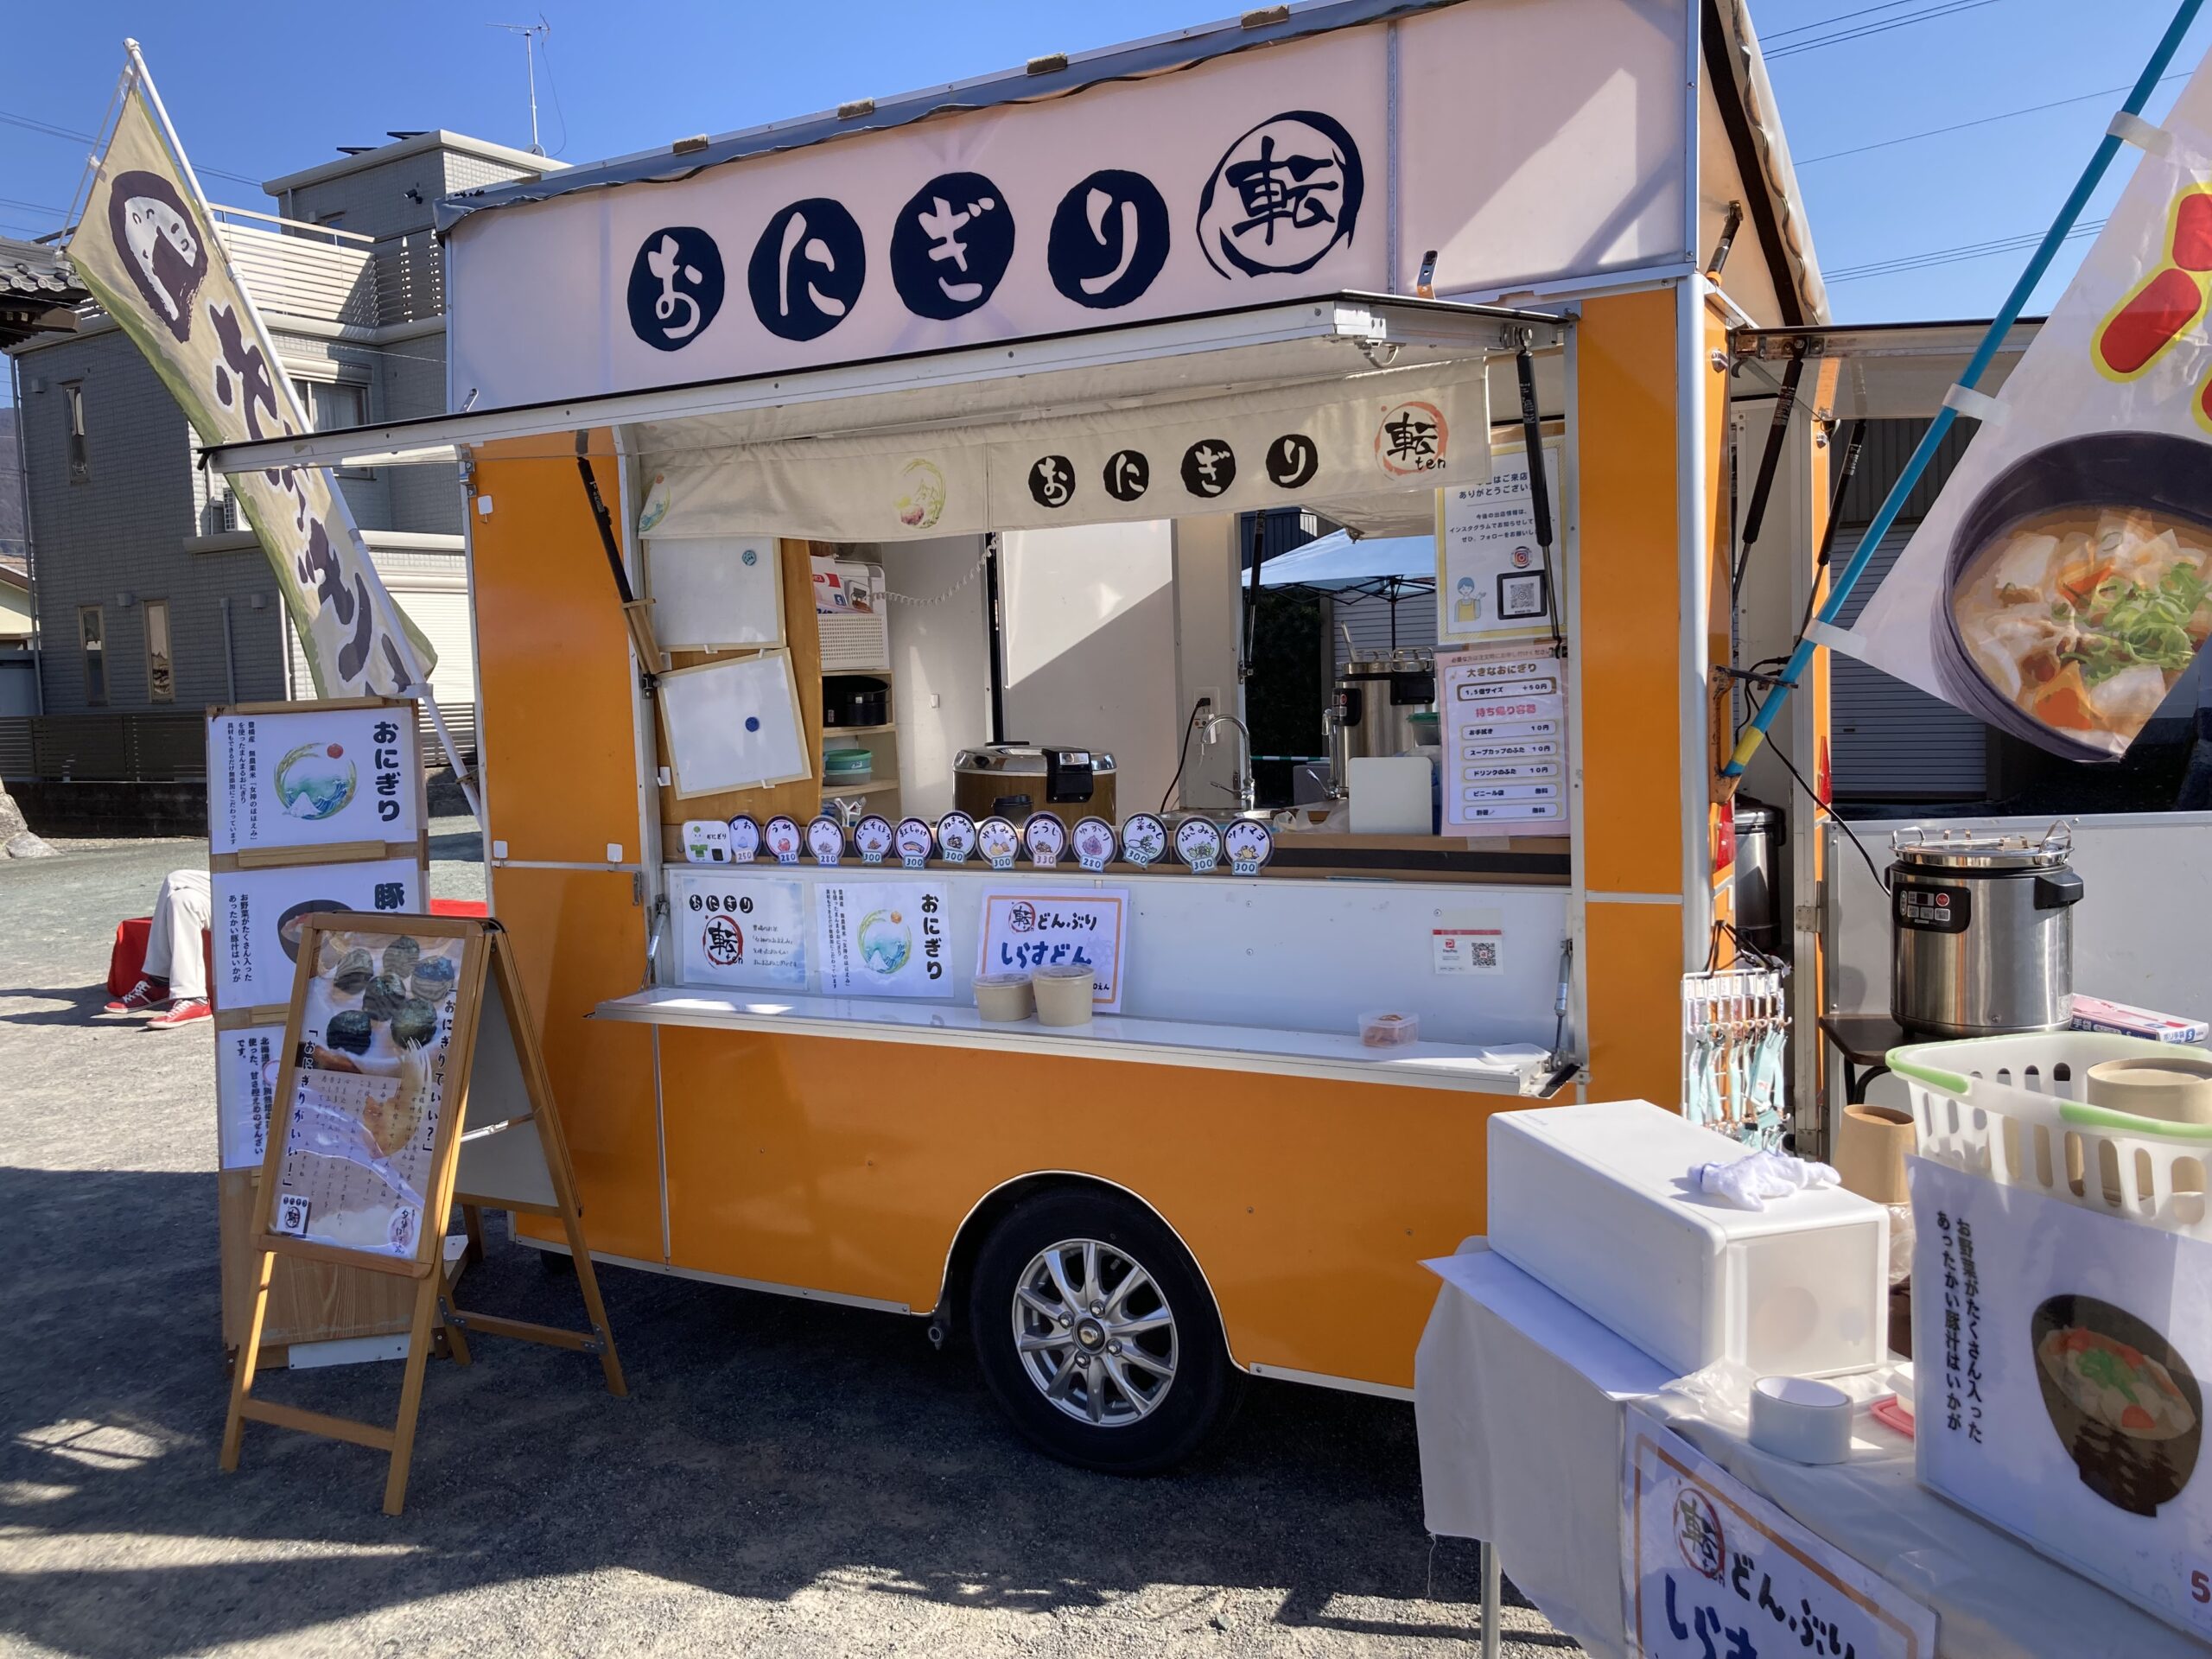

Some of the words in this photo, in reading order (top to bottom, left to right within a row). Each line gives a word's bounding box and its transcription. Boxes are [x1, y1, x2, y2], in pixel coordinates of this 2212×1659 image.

[641, 181, 1150, 343] おにぎり
[1220, 130, 1344, 251] 転
[1034, 438, 1310, 505] おにぎり
[1384, 412, 1438, 461] 転
[1416, 457, 1446, 470] ten
[1477, 471, 1529, 486] はご来店
[1459, 484, 1533, 499] ありがとうござい
[1461, 530, 1535, 543] ぜひ、フォローをお願いし
[1466, 663, 1537, 678] 大きなおにぎり
[1475, 704, 1536, 717] 持ち帰り容器
[1470, 747, 1525, 756] スープカップのふた
[238, 722, 246, 804] を使ったまんまるおにぎり
[372, 721, 401, 822] おにぎり
[1473, 767, 1516, 776] ドリンクのふた
[733, 822, 752, 830] しお
[772, 823, 791, 833] うめ
[1033, 822, 1058, 836] こうじ
[1228, 825, 1266, 842] ツナマヨ
[738, 852, 752, 861] 250
[821, 855, 836, 863] 280
[864, 853, 880, 861] 300
[907, 858, 923, 867] 300
[945, 851, 963, 861] 300
[994, 858, 1011, 867] 300
[1037, 855, 1054, 864] 330
[1083, 858, 1101, 868] 280
[1127, 850, 1147, 864] 300
[1194, 859, 1213, 869] 300
[1235, 863, 1255, 873] 300
[374, 882, 406, 912] 豚
[691, 894, 752, 913] おにぎり
[1013, 906, 1033, 927] 転
[1038, 912, 1097, 931] どんぶり
[228, 894, 241, 982] あったかい豚汁はいかが
[240, 893, 252, 982] お野菜がたくさん入った
[708, 921, 738, 956] 転
[921, 893, 943, 980] おにぎり
[1001, 940, 1092, 969] しらすどん
[237, 1039, 246, 1059] です。
[1936, 1211, 1962, 1431] あったかい豚汁はいかが
[1956, 1217, 1982, 1445] お野菜がたくさん入った
[1731, 1552, 1855, 1659] どんぶり
